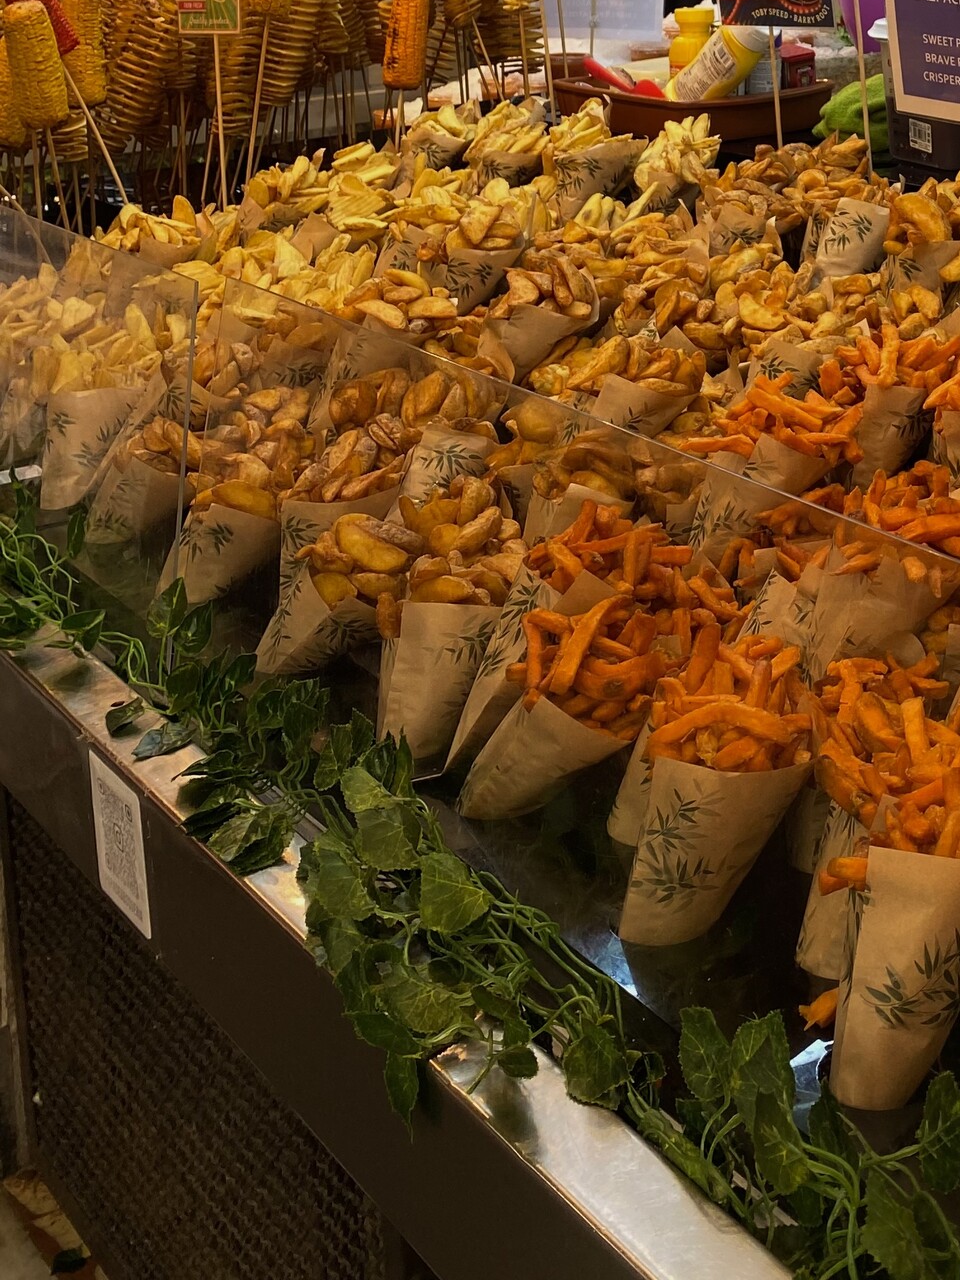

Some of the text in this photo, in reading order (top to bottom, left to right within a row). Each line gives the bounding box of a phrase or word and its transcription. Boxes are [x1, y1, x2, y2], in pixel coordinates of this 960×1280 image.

[752, 5, 831, 24] TOBY SPEED BARRY ROOT
[922, 33, 954, 48] SWEET
[925, 52, 955, 66] BRAVE
